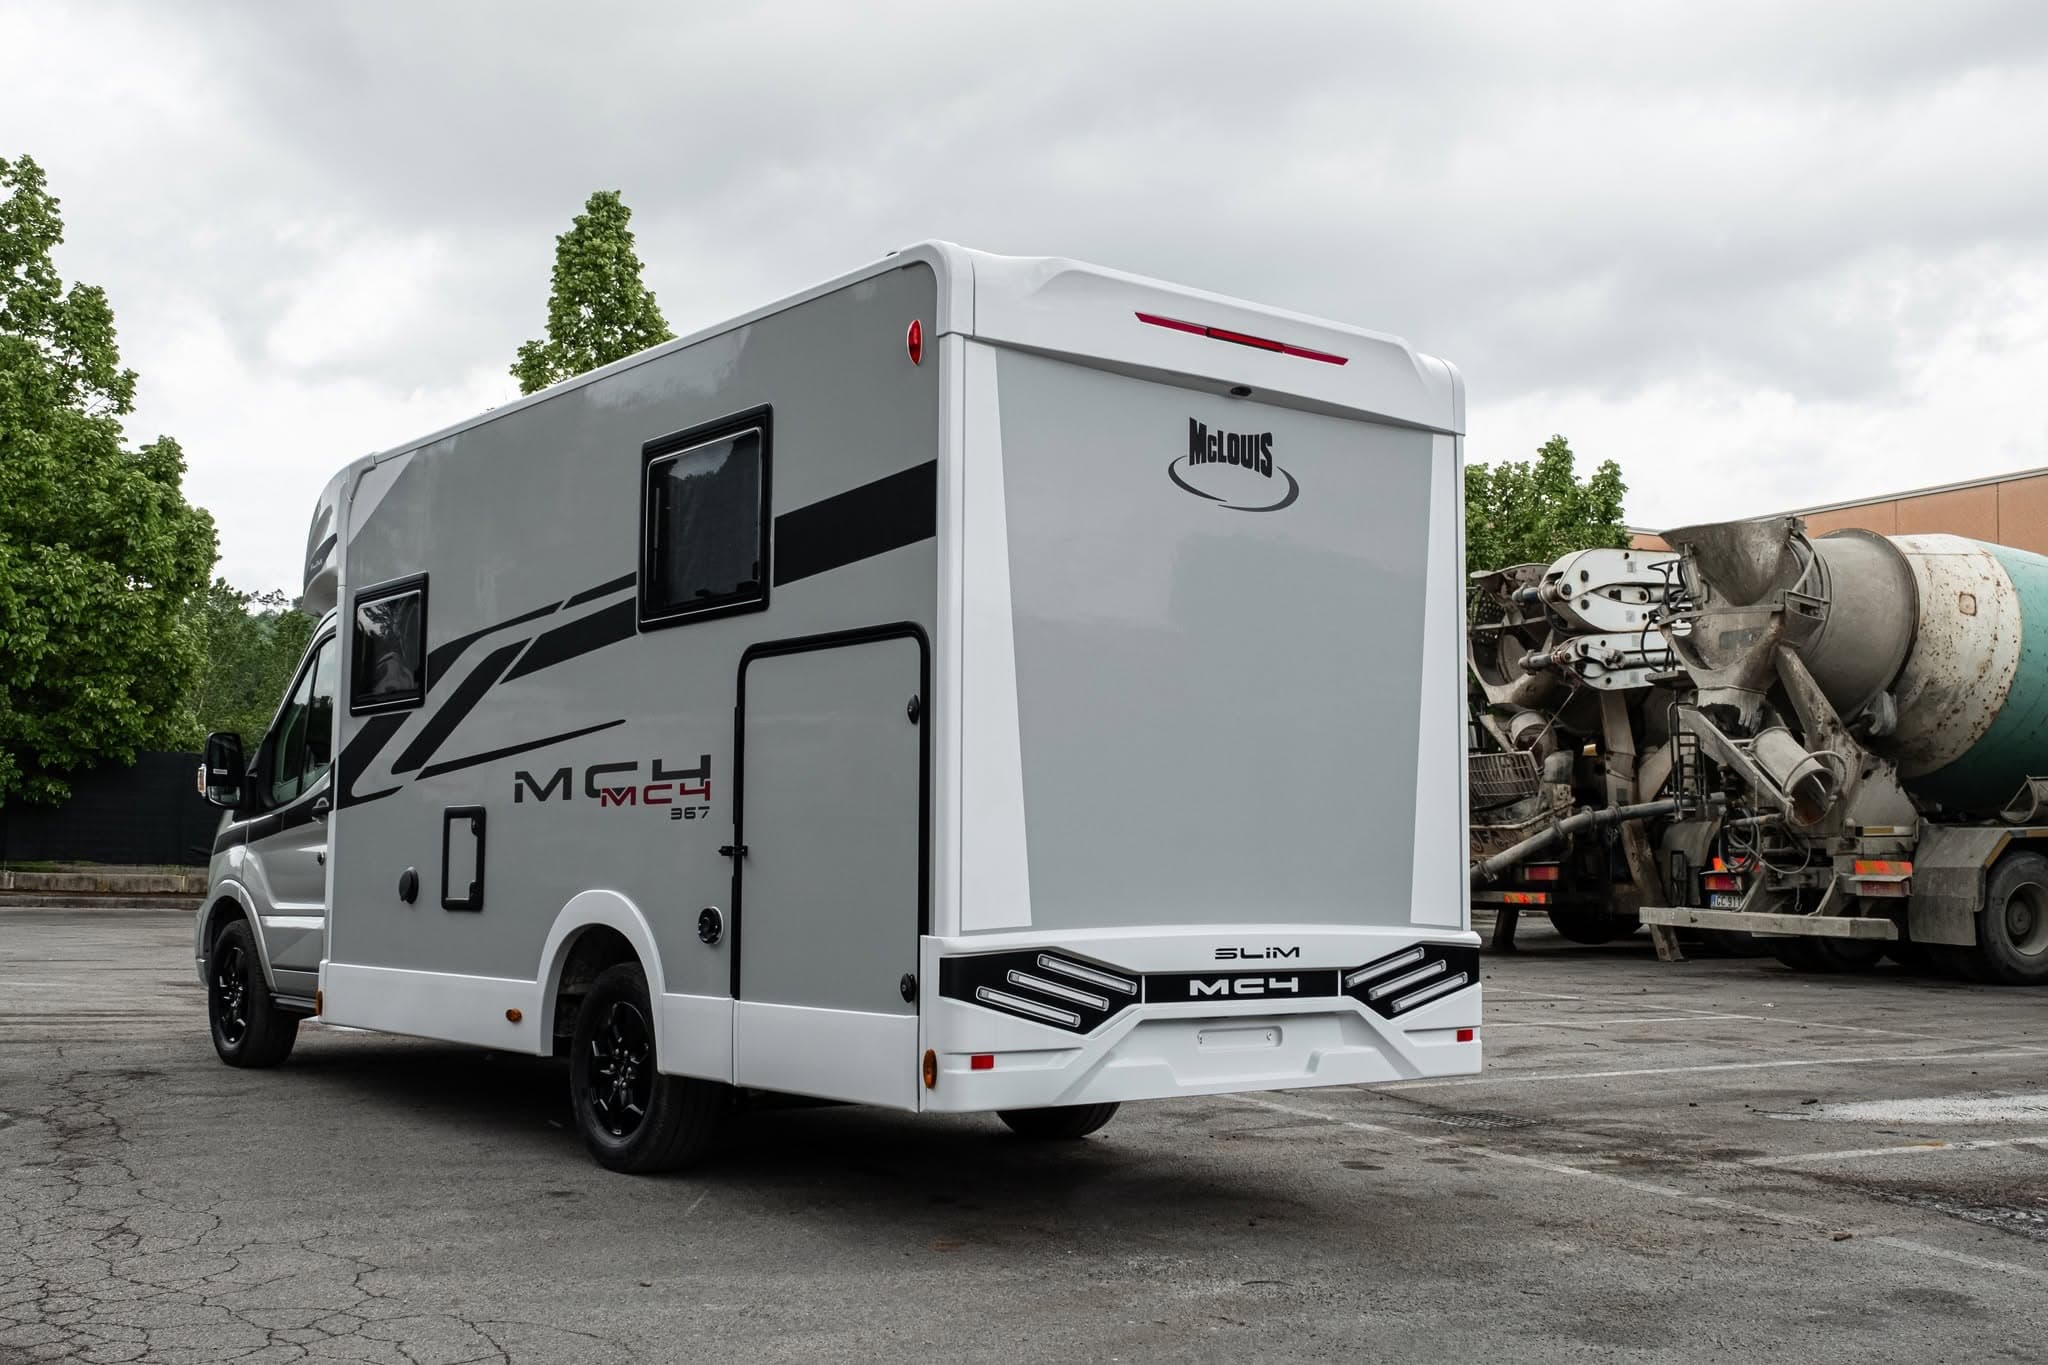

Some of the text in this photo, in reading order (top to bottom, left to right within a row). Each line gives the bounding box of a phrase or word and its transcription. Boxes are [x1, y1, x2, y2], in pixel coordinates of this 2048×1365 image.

[514, 754, 712, 803] MC4
[601, 780, 711, 807] MC4
[671, 806, 710, 820] 367
[1189, 977, 1299, 996] MC4
